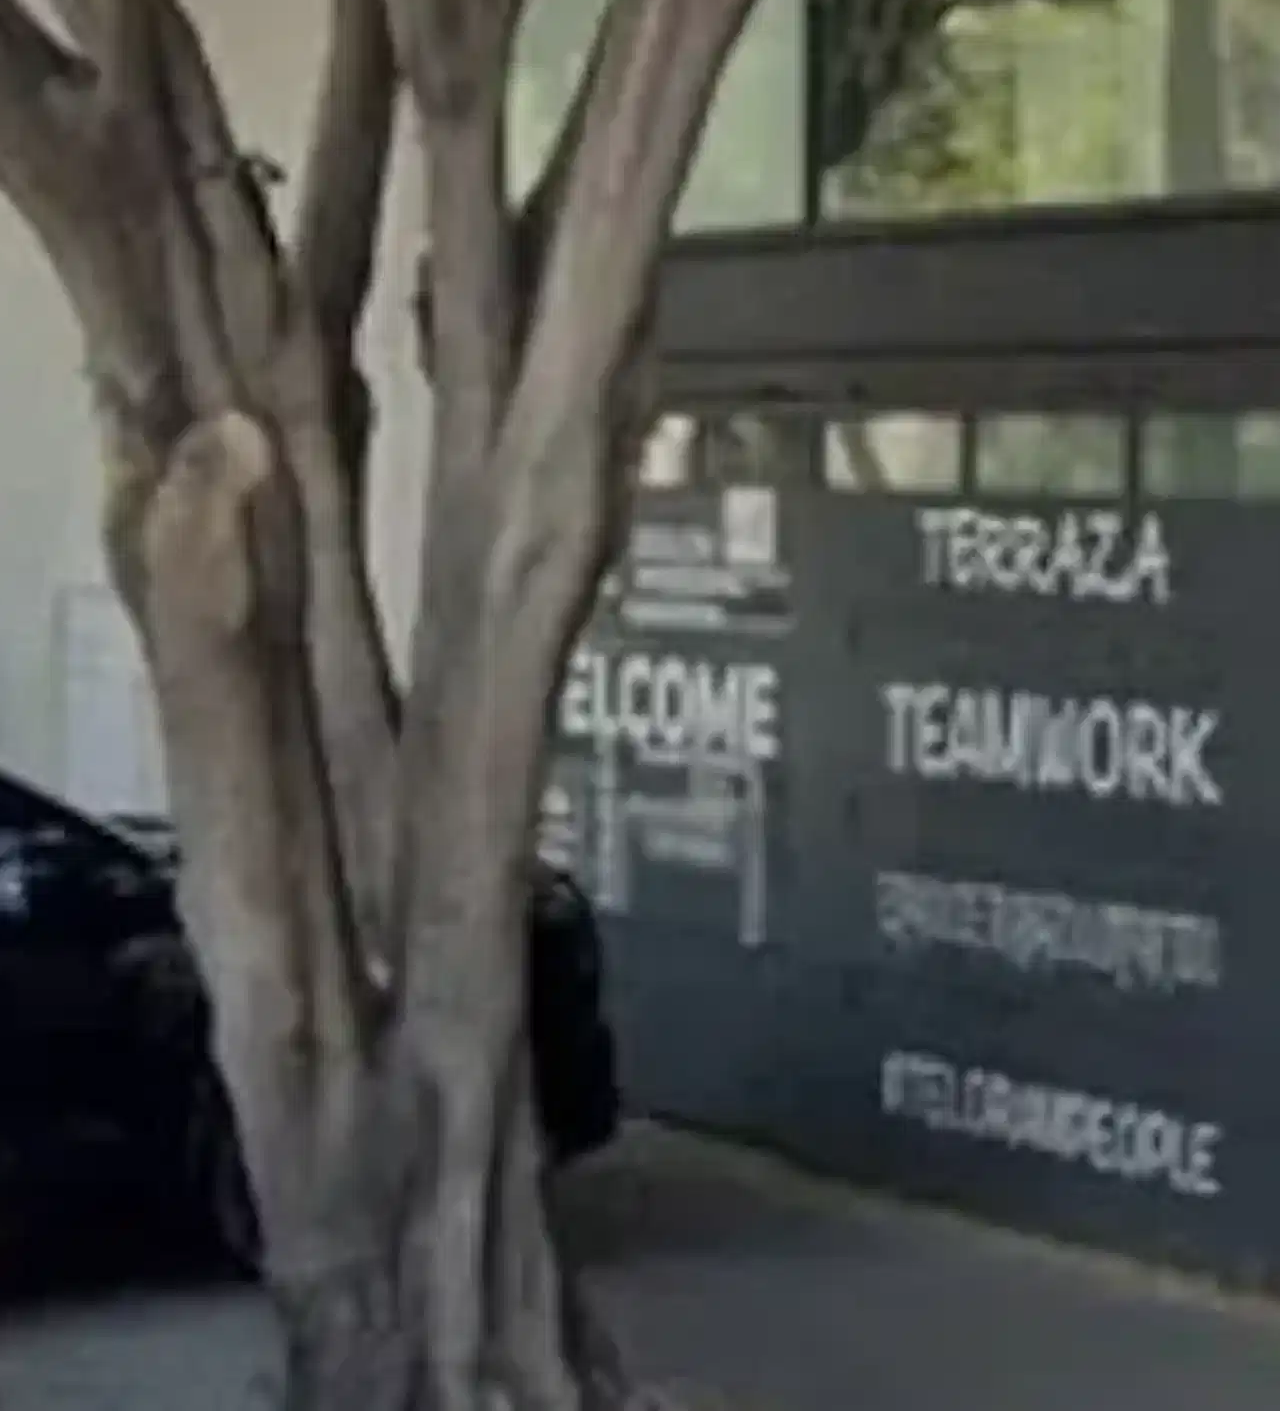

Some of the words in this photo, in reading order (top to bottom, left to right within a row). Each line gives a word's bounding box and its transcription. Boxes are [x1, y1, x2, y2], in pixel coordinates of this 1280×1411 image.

[917, 507, 1172, 604] TERRAZA
[558, 639, 780, 761] ELCOME
[880, 682, 1221, 806] TEAMWORK
